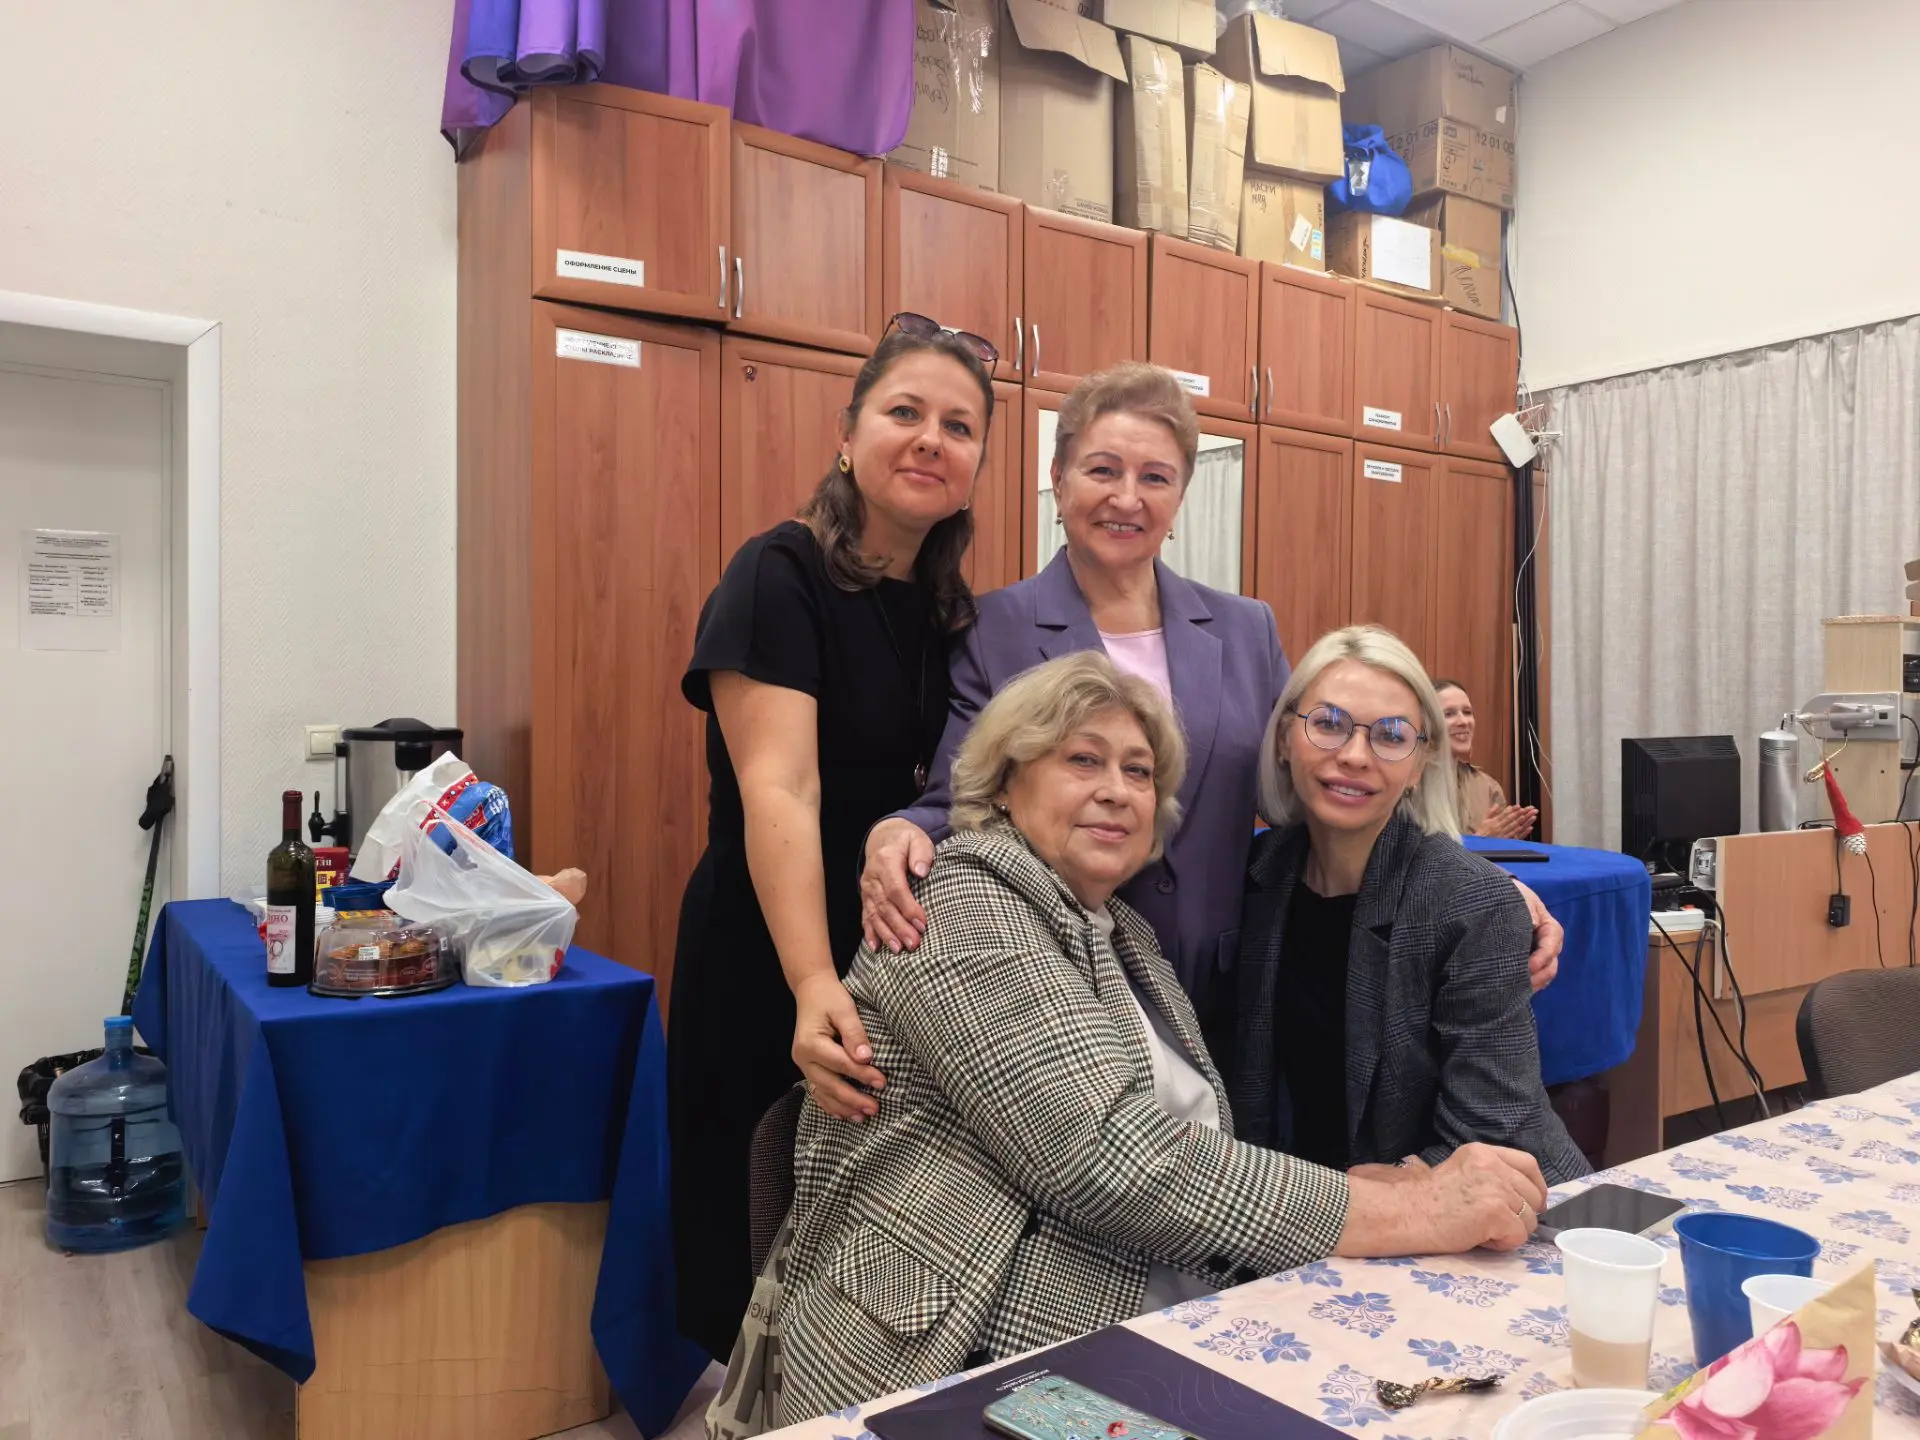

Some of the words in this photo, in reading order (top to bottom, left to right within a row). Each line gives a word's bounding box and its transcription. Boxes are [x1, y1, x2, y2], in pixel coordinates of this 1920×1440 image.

[1476, 132, 1487, 147] 12
[1489, 136, 1500, 150] 01
[564, 260, 612, 272] ОФОРМЛЕНИЕ
[613, 265, 637, 275] СЦЕНЫ
